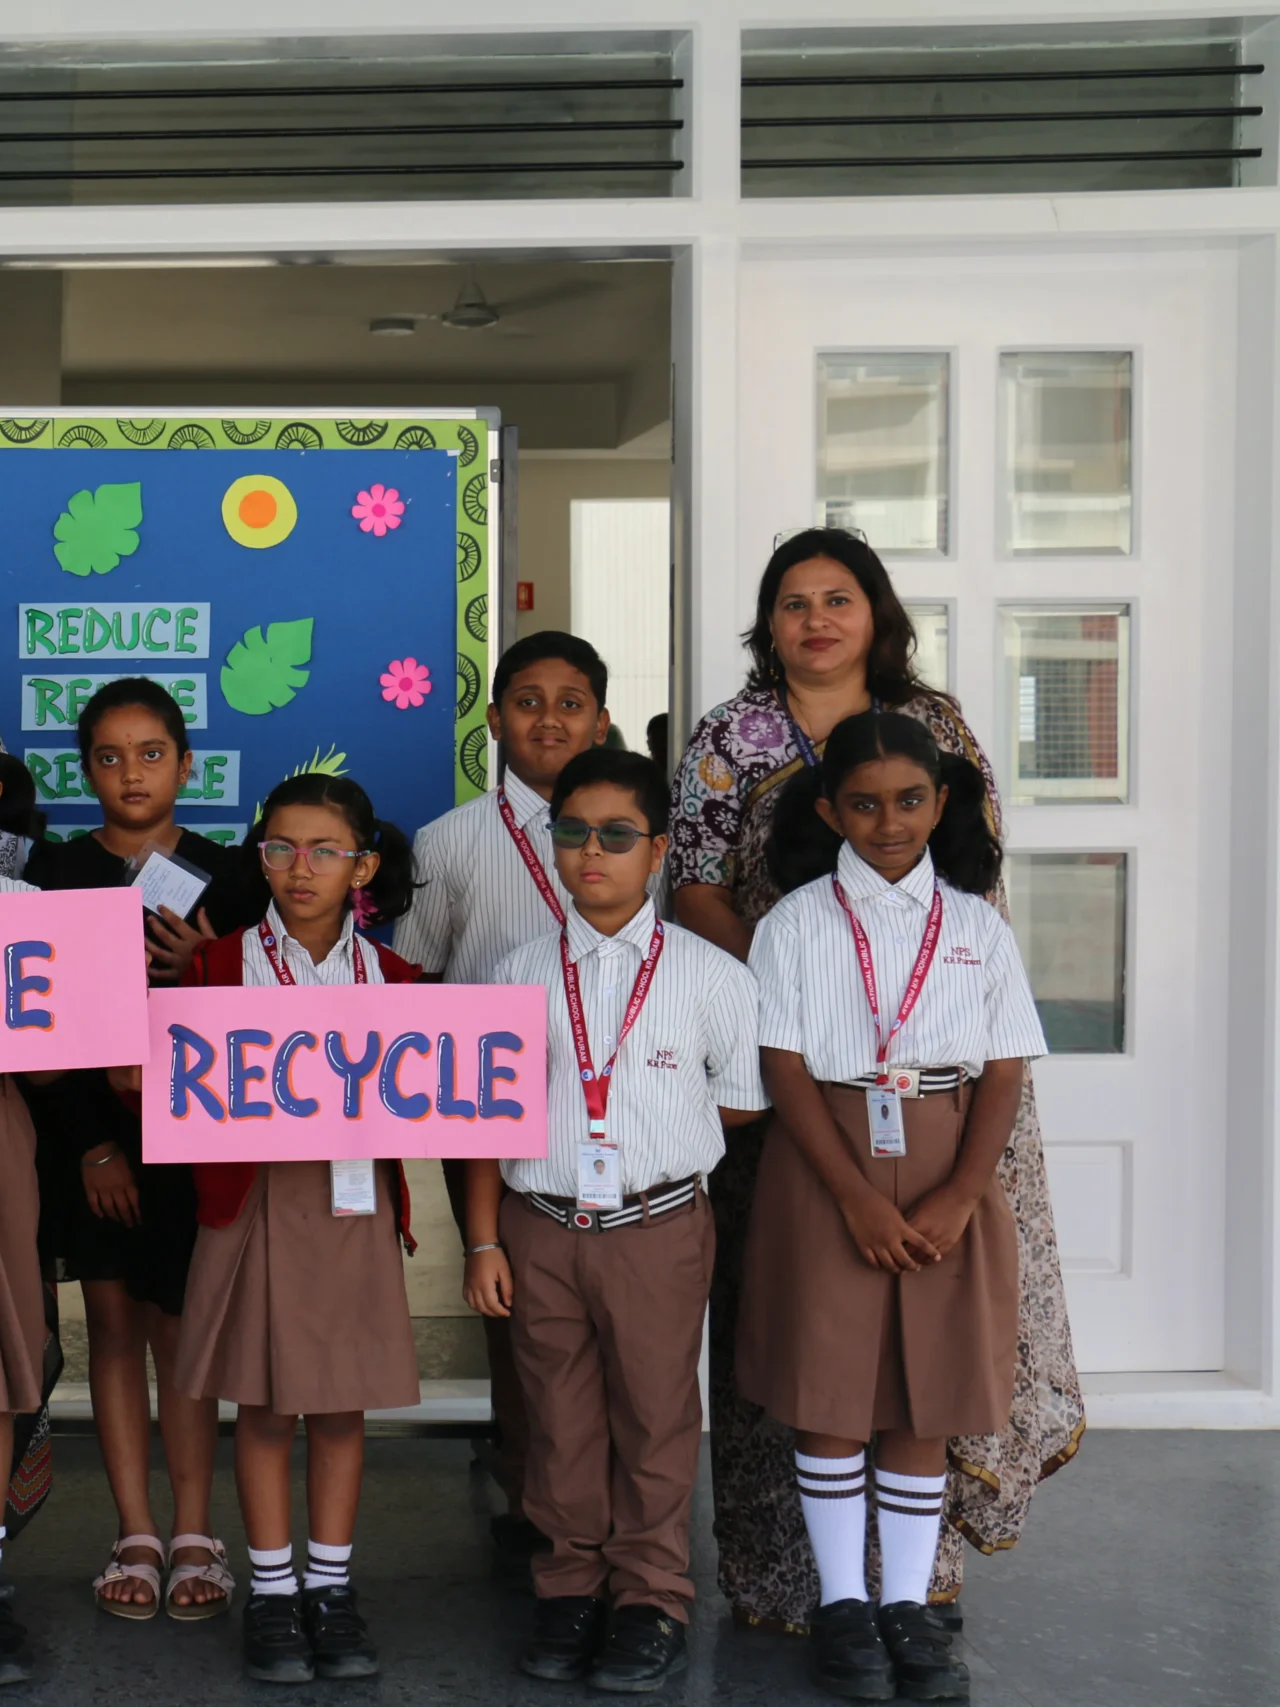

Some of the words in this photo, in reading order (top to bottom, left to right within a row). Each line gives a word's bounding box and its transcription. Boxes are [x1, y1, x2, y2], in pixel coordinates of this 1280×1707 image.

[24, 606, 199, 656] REDUCE
[27, 678, 197, 726] REE
[514, 829, 521, 839] KR
[520, 839, 535, 865] SCHOOL
[532, 864, 546, 889] PUBLIC
[543, 889, 563, 921] NATIONAL
[931, 895, 941, 924] NATIONAL
[649, 938, 661, 961] PURAM
[924, 924, 936, 951] PUBLIC
[644, 960, 653, 970] KR
[859, 941, 871, 968] PUBLIC
[917, 949, 930, 977] SCHOOL
[950, 947, 971, 957] NPS
[281, 972, 291, 984] KR
[566, 967, 576, 992] PUBLIC
[638, 969, 651, 997] SCHOOL
[865, 969, 876, 1008] NATIONAL
[910, 977, 920, 989] KR
[569, 992, 580, 1023] SCHOOL
[627, 997, 641, 1024] PUBLIC
[901, 988, 917, 1015] PURAM
[574, 1023, 583, 1036] KR
[576, 1036, 588, 1063] PURAM
[656, 1050, 674, 1060] NPS
[167, 1023, 525, 1123] RECYCLE
